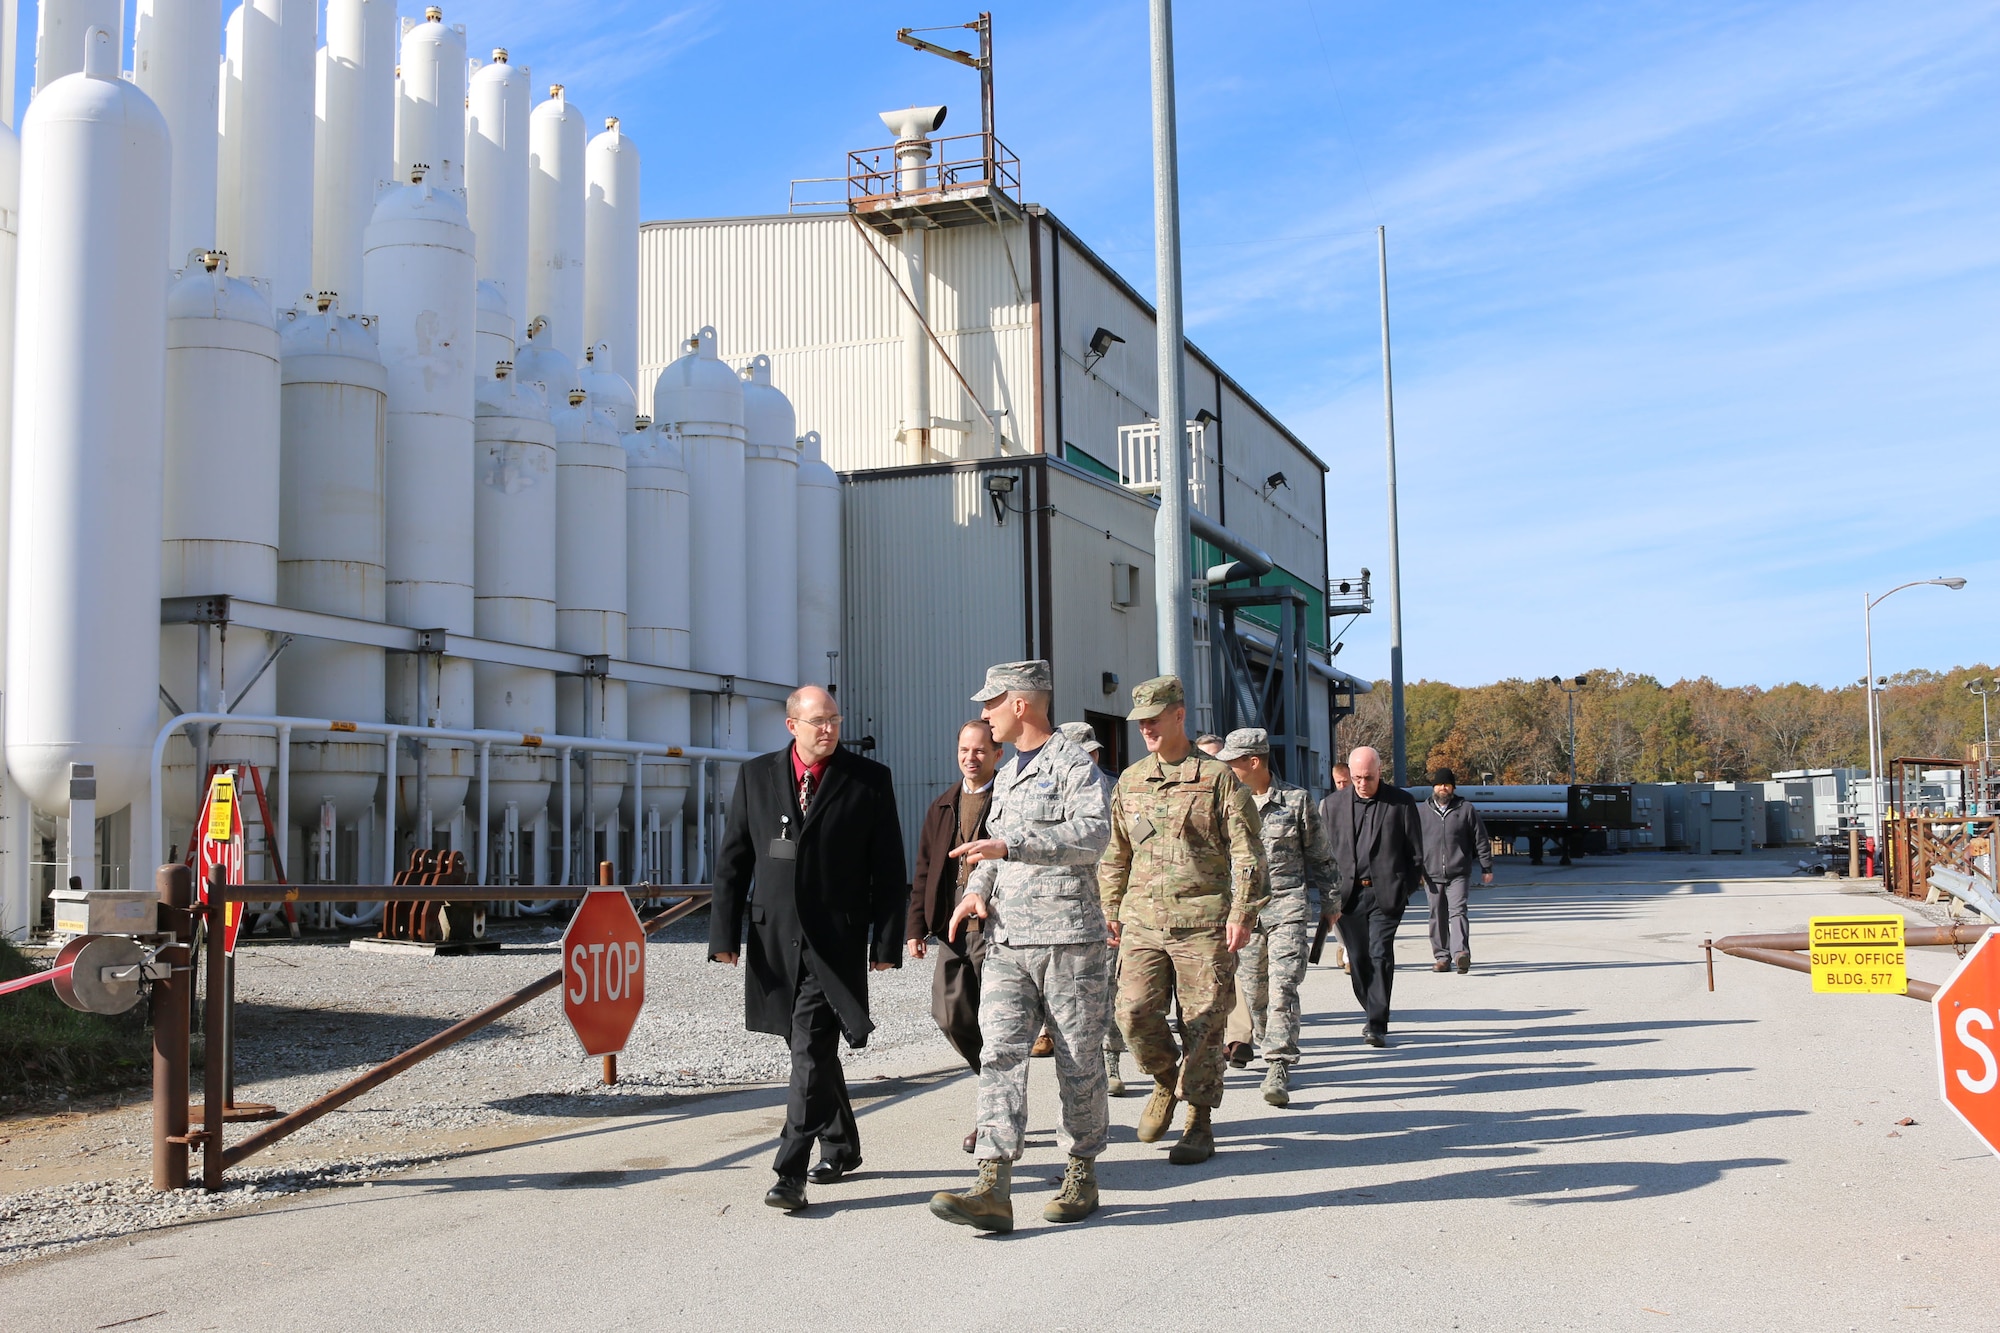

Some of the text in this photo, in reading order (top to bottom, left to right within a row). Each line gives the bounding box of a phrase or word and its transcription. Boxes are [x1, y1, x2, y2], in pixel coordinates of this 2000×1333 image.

[1814, 926, 1898, 940] CHECK IN AT
[1812, 953, 1904, 965] SUPV. OFFICE
[569, 941, 640, 1005] STOP
[1827, 973, 1892, 985] BLDG. 577
